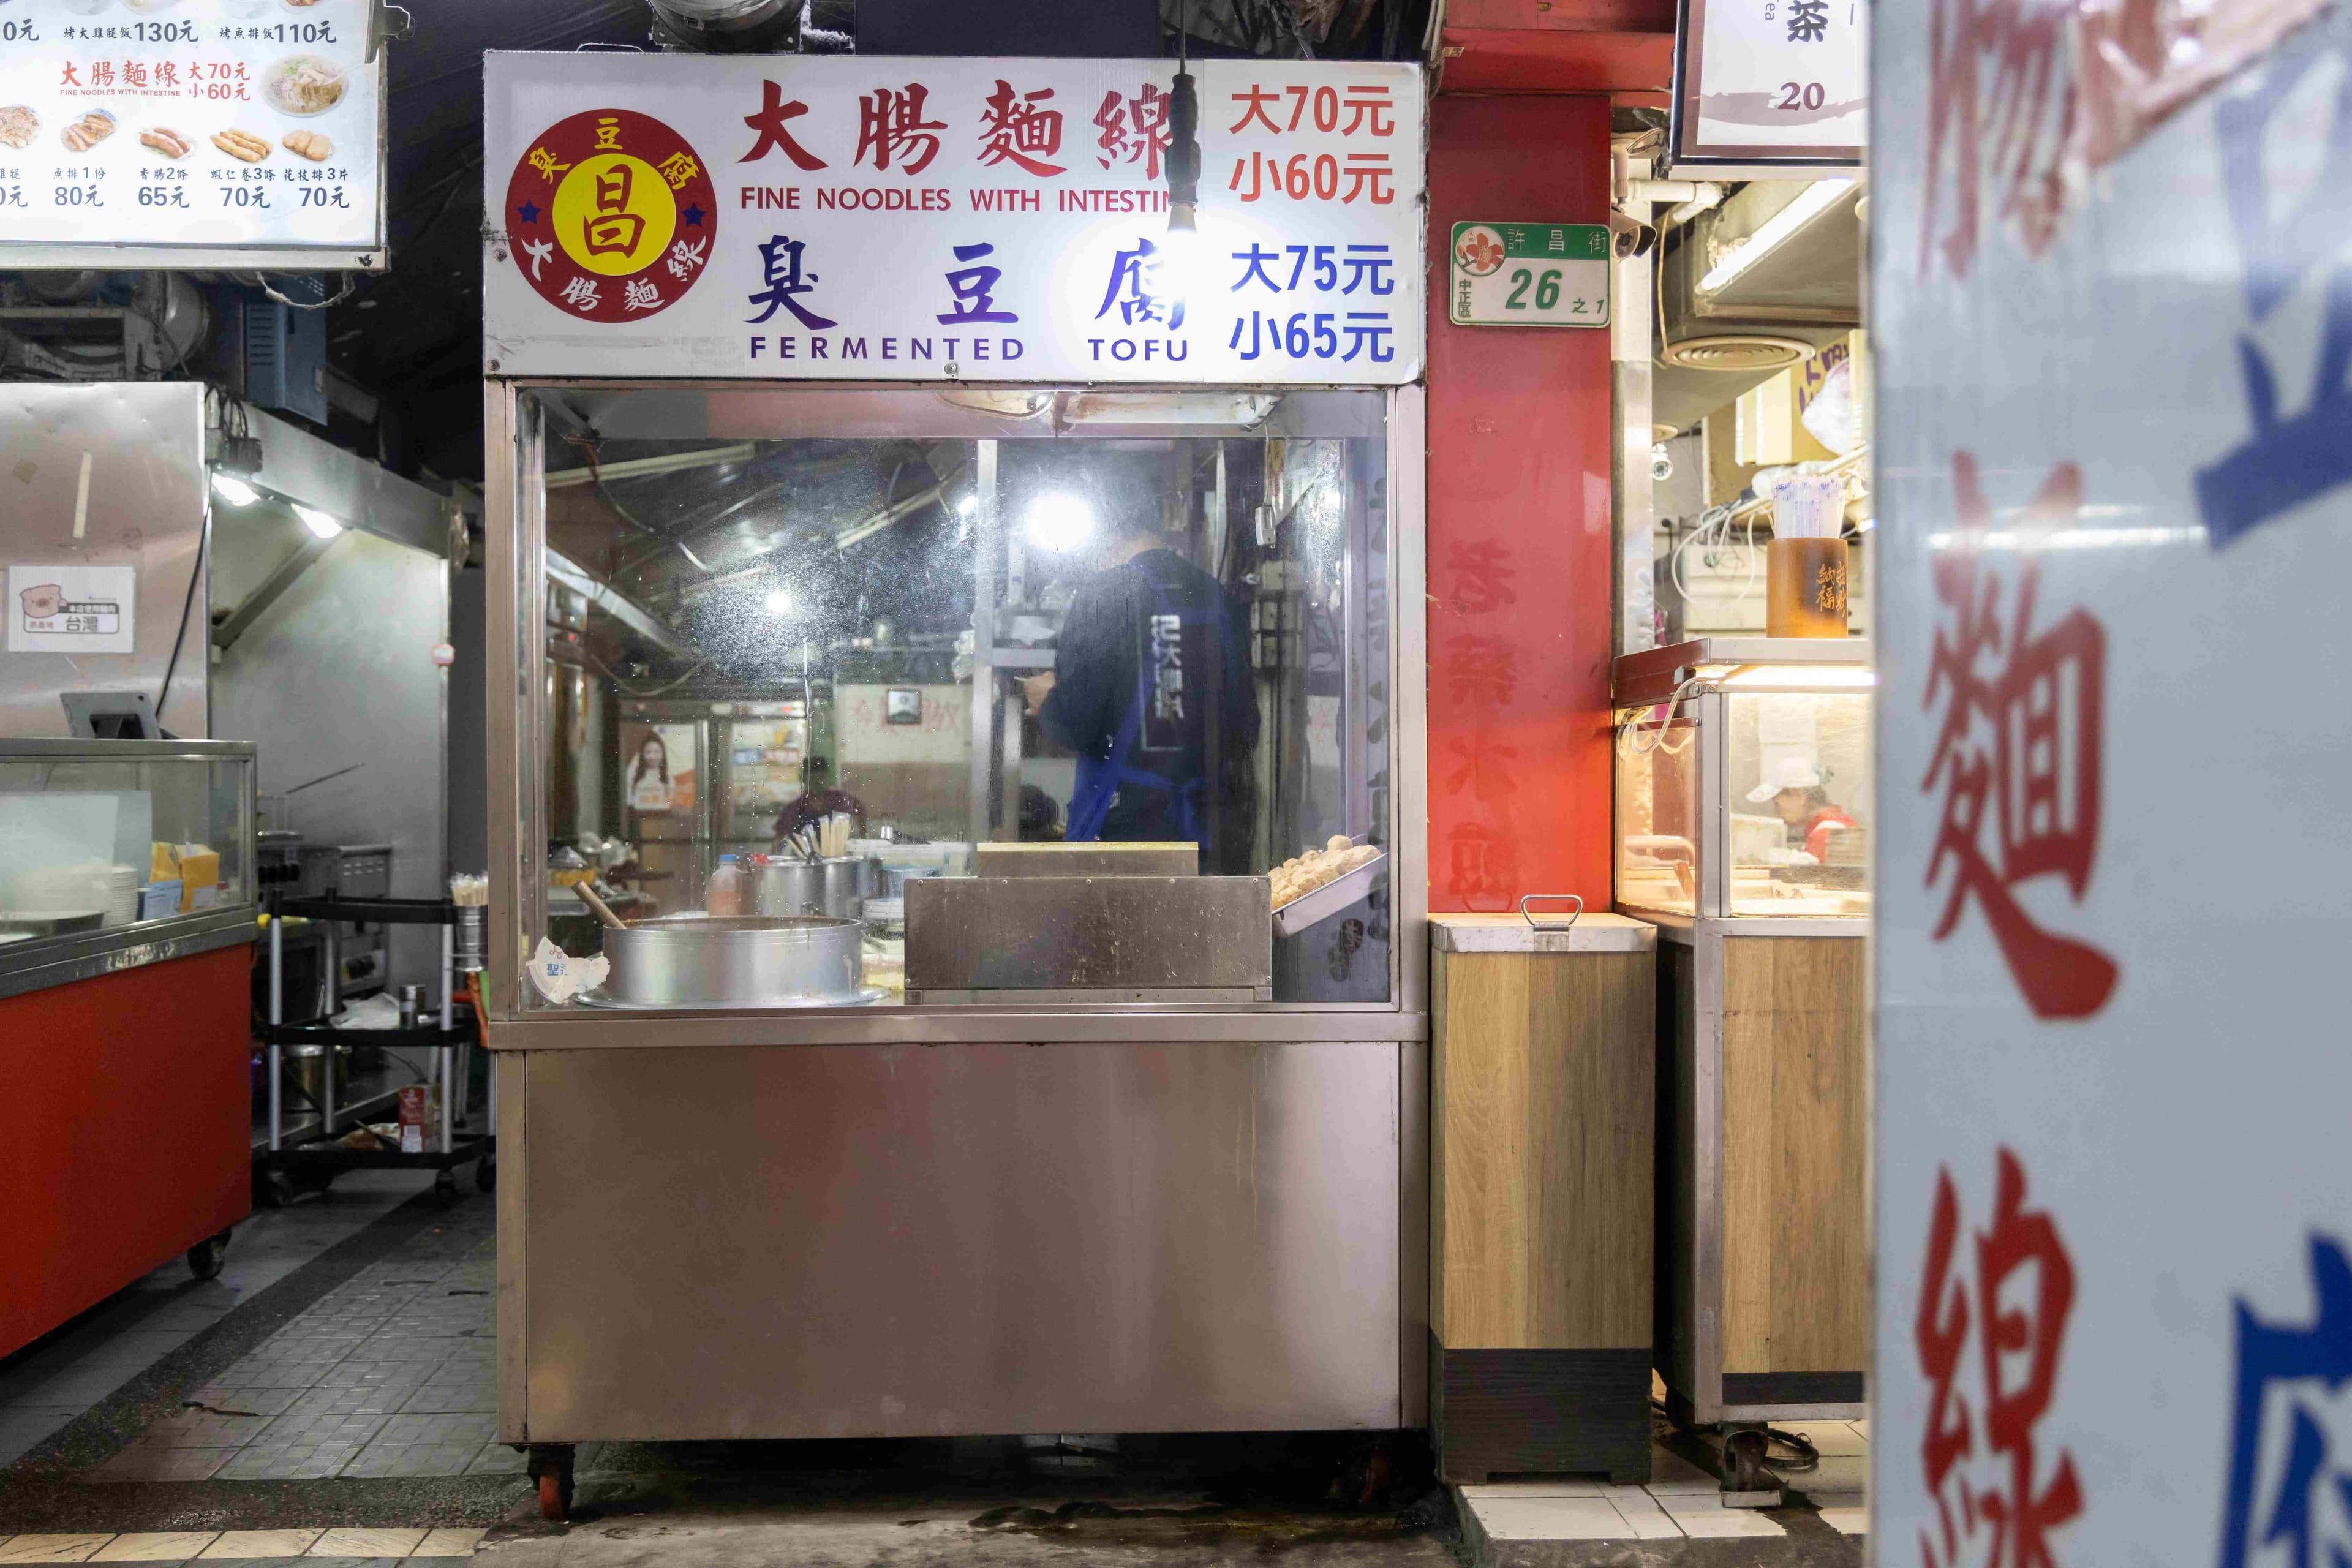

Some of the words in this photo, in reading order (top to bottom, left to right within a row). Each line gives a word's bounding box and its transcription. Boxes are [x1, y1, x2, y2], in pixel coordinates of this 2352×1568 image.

[63, 26, 132, 40] 烤大雞腿飯
[134, 19, 198, 42] 130元
[219, 27, 275, 40] 烤魚排飯
[274, 20, 337, 43] 110元
[1787, 0, 1829, 42] 茶
[60, 59, 181, 88] 大腸麵線
[187, 61, 251, 81] 大70元
[188, 83, 251, 101] 小60元
[1777, 82, 1825, 111] 20
[1229, 84, 1395, 137] 大70元
[737, 79, 1173, 181] 大腸麵線
[528, 117, 700, 190] 臭豆腐
[53, 167, 106, 180] 魚排1份
[140, 167, 189, 180] 香腸2條
[284, 167, 349, 181] 花枝排3片
[1229, 151, 1395, 205] 小60元
[55, 185, 104, 207] 80元
[138, 186, 190, 208] 65元
[220, 186, 271, 209] 70元
[298, 186, 350, 209] 70元
[741, 187, 801, 209] FINE
[816, 188, 951, 211] NOODLES
[969, 189, 1040, 212] WITH
[1059, 190, 1196, 213] INTESTI
[583, 164, 646, 258] 昌
[1507, 228, 1607, 253] 許昌街
[521, 235, 707, 312] 大腸麵線
[1229, 243, 1395, 295] 大75元
[744, 234, 1186, 331] 臭豆腐
[1505, 268, 1562, 311] 26
[1458, 279, 1472, 318] 中正區
[750, 336, 1024, 360] FERMENTED
[1088, 339, 1188, 361] TOFU
[1229, 311, 1395, 363] 小65元
[66, 615, 98, 633] 台灣
